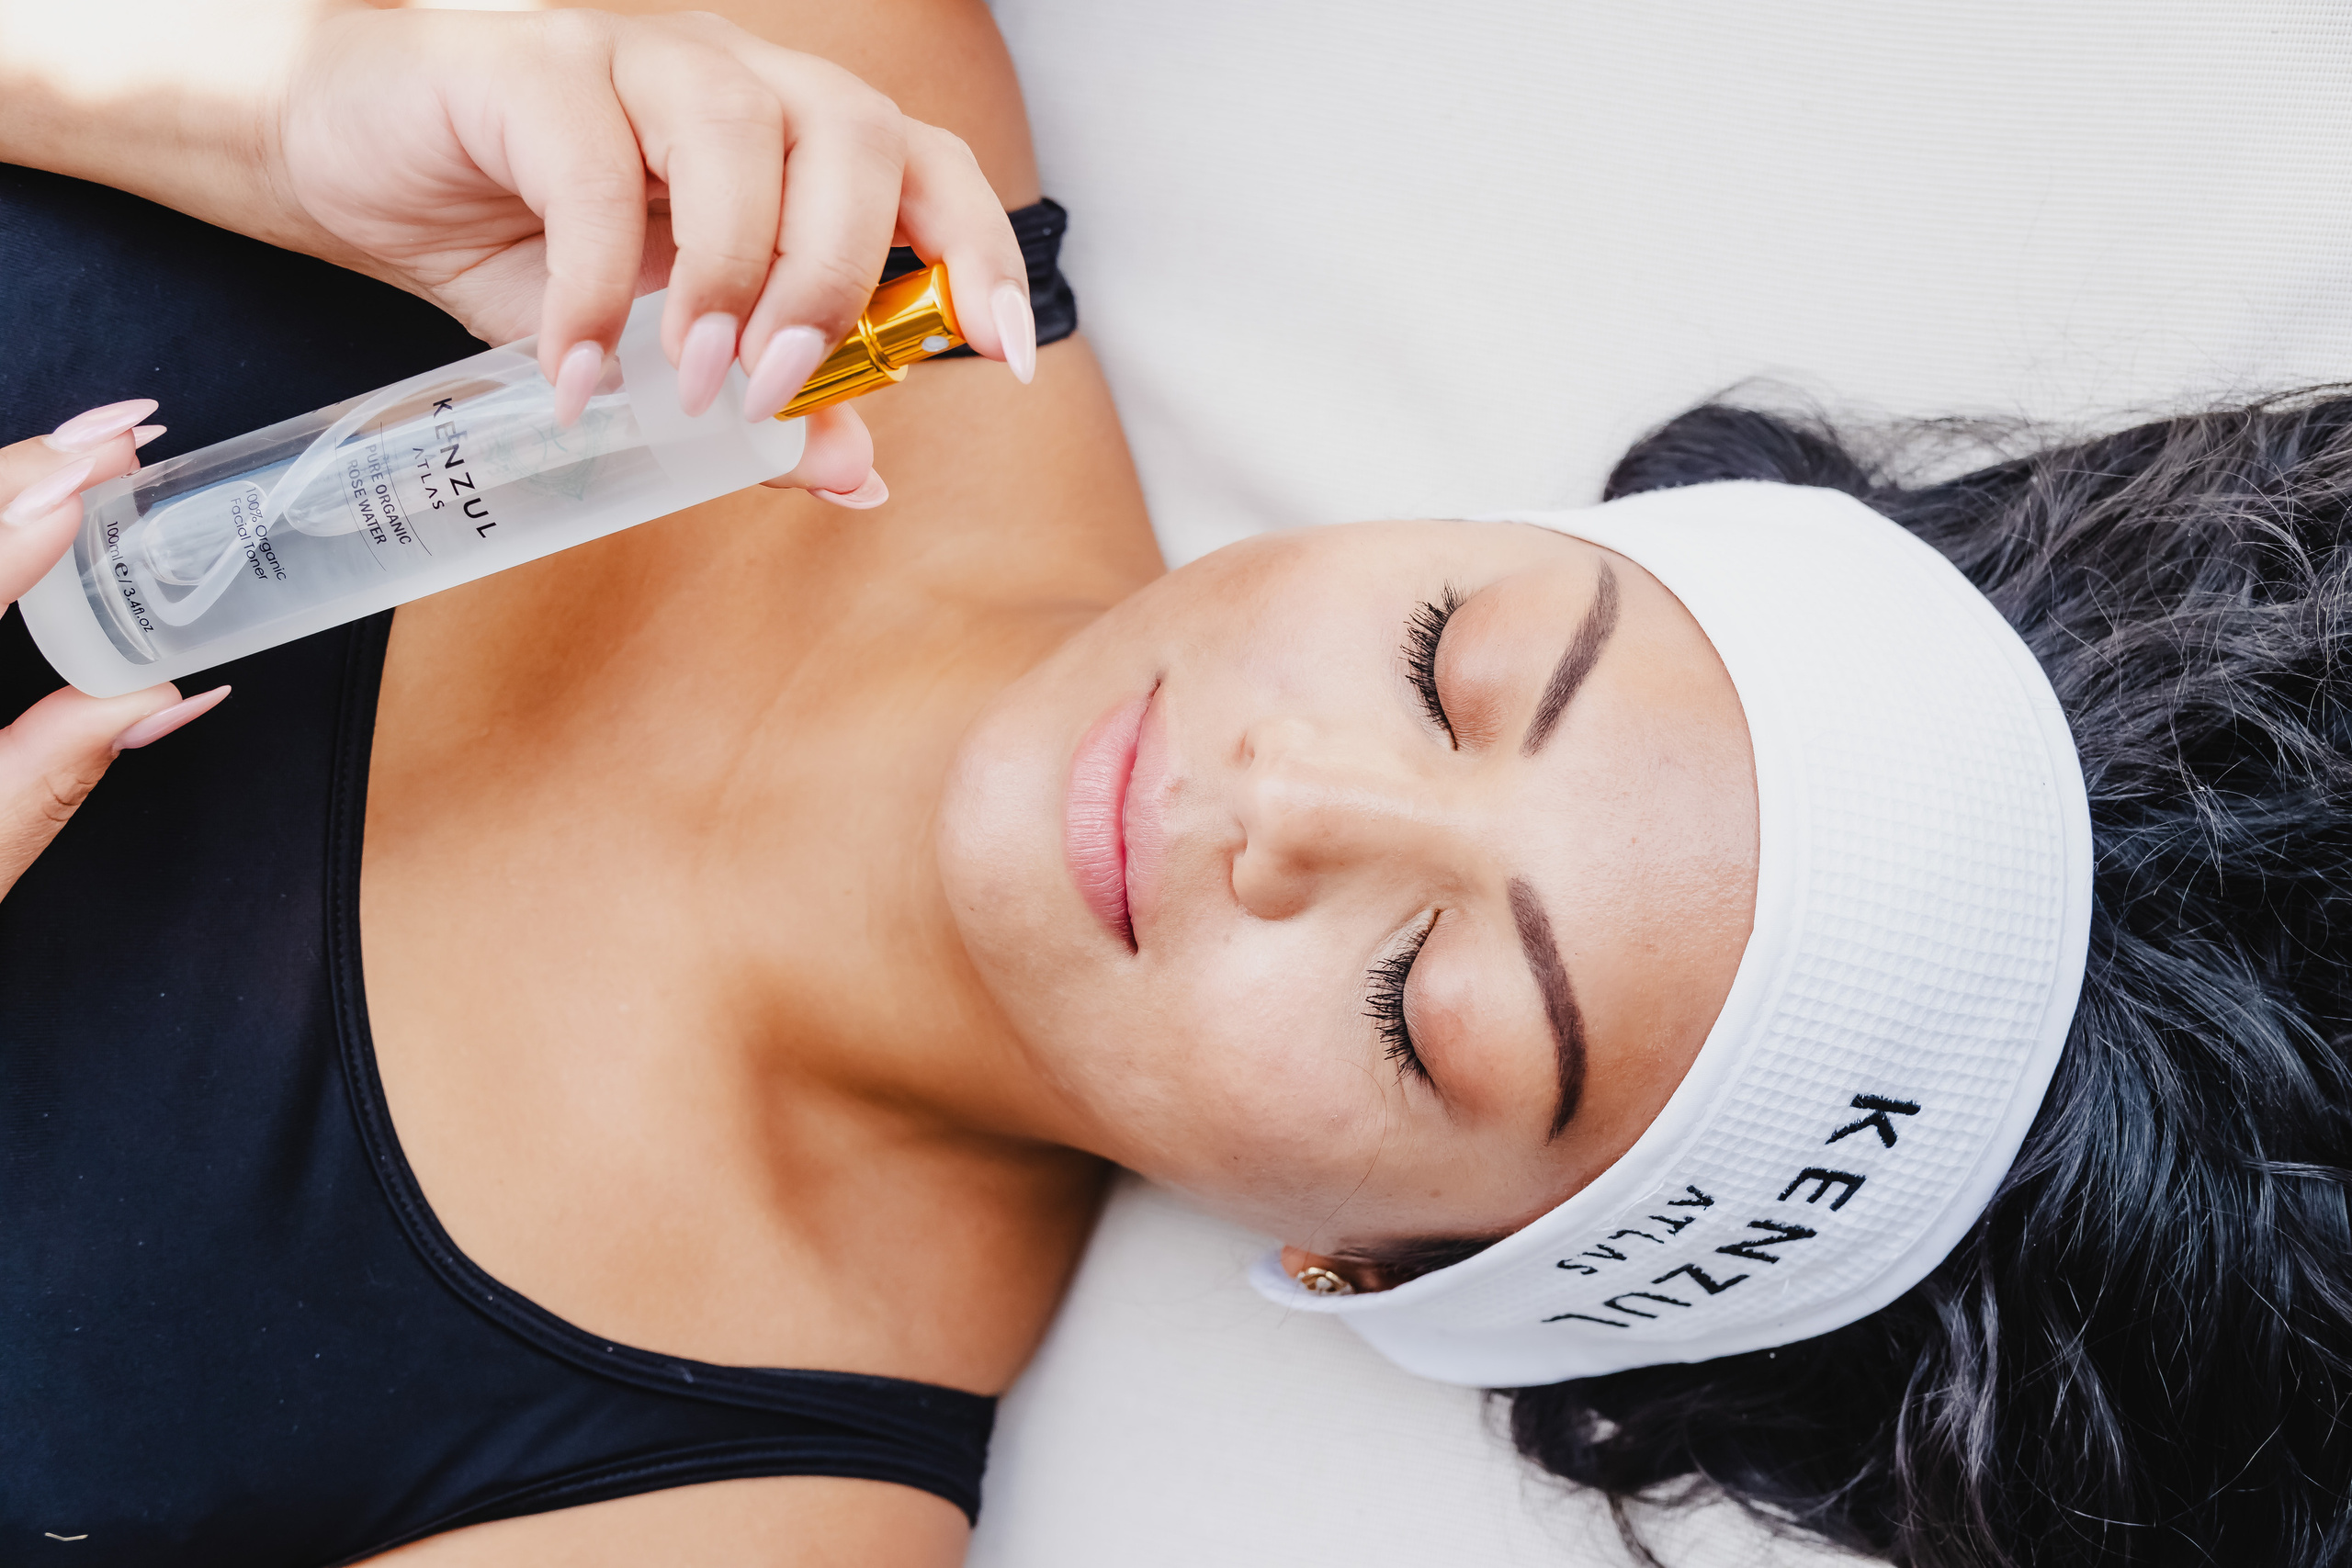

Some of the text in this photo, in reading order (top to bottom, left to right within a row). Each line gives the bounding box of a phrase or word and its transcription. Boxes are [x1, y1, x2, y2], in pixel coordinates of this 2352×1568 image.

[347, 458, 388, 545] ROSE WATER
[366, 444, 413, 545] PURE ORGANIC
[413, 447, 446, 510] ATLAS
[433, 397, 497, 538] KENZUL
[107, 521, 124, 561] 100ml
[231, 497, 268, 581] Facial Toner
[245, 487, 287, 581] 100% Organic
[1541, 1093, 1922, 1328] KENZUL
[1556, 1184, 1715, 1275] ATLAS
